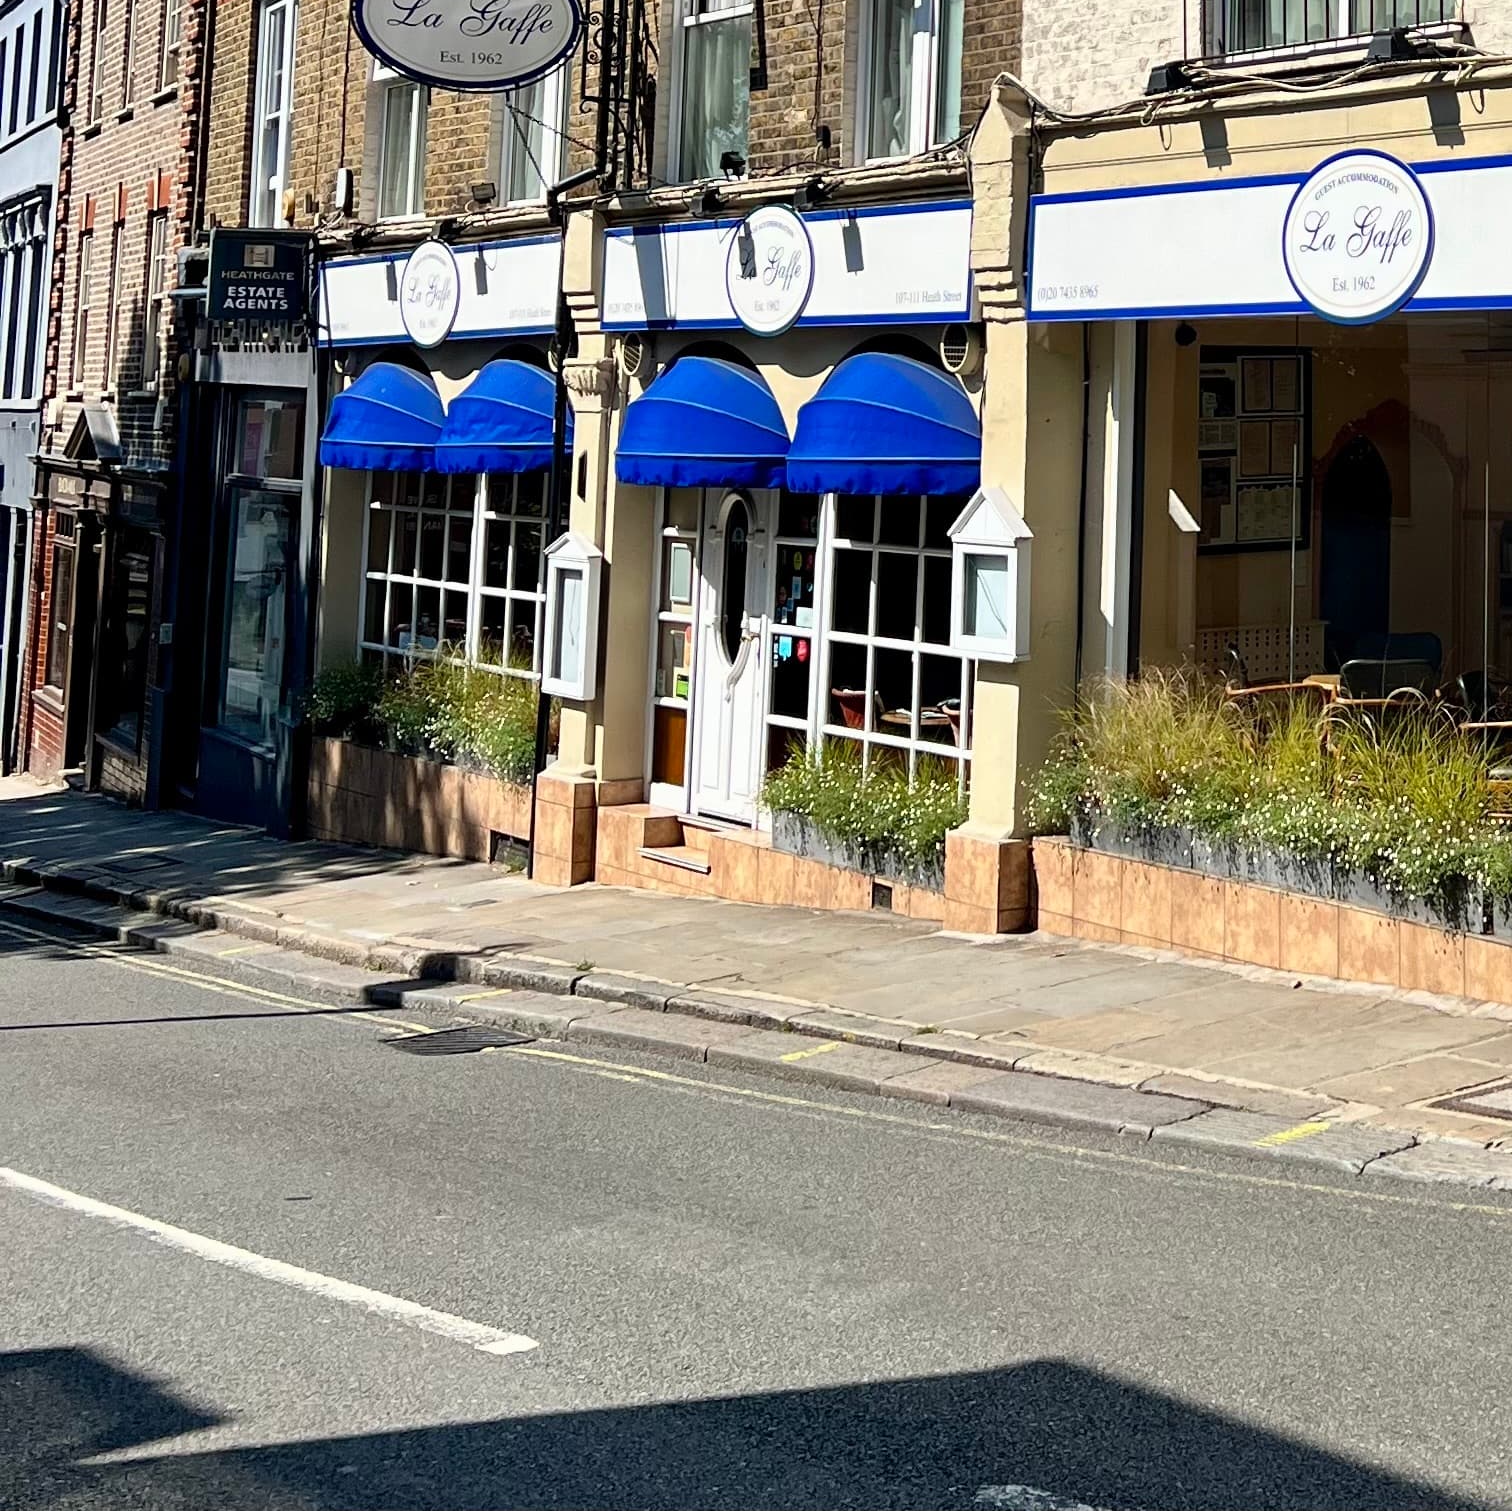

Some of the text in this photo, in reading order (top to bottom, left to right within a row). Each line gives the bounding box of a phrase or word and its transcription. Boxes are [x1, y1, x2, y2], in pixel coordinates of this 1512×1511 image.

[440, 51, 503, 65] Est. 1962
[1315, 180, 1337, 200] GUEST
[1300, 205, 1412, 264] La Gaffe
[221, 270, 295, 281] HEATHGATE
[763, 246, 802, 291] Gaffe
[1333, 276, 1376, 292] Est. 1962
[227, 286, 285, 298] ESTATE
[223, 298, 288, 310] AGENTS
